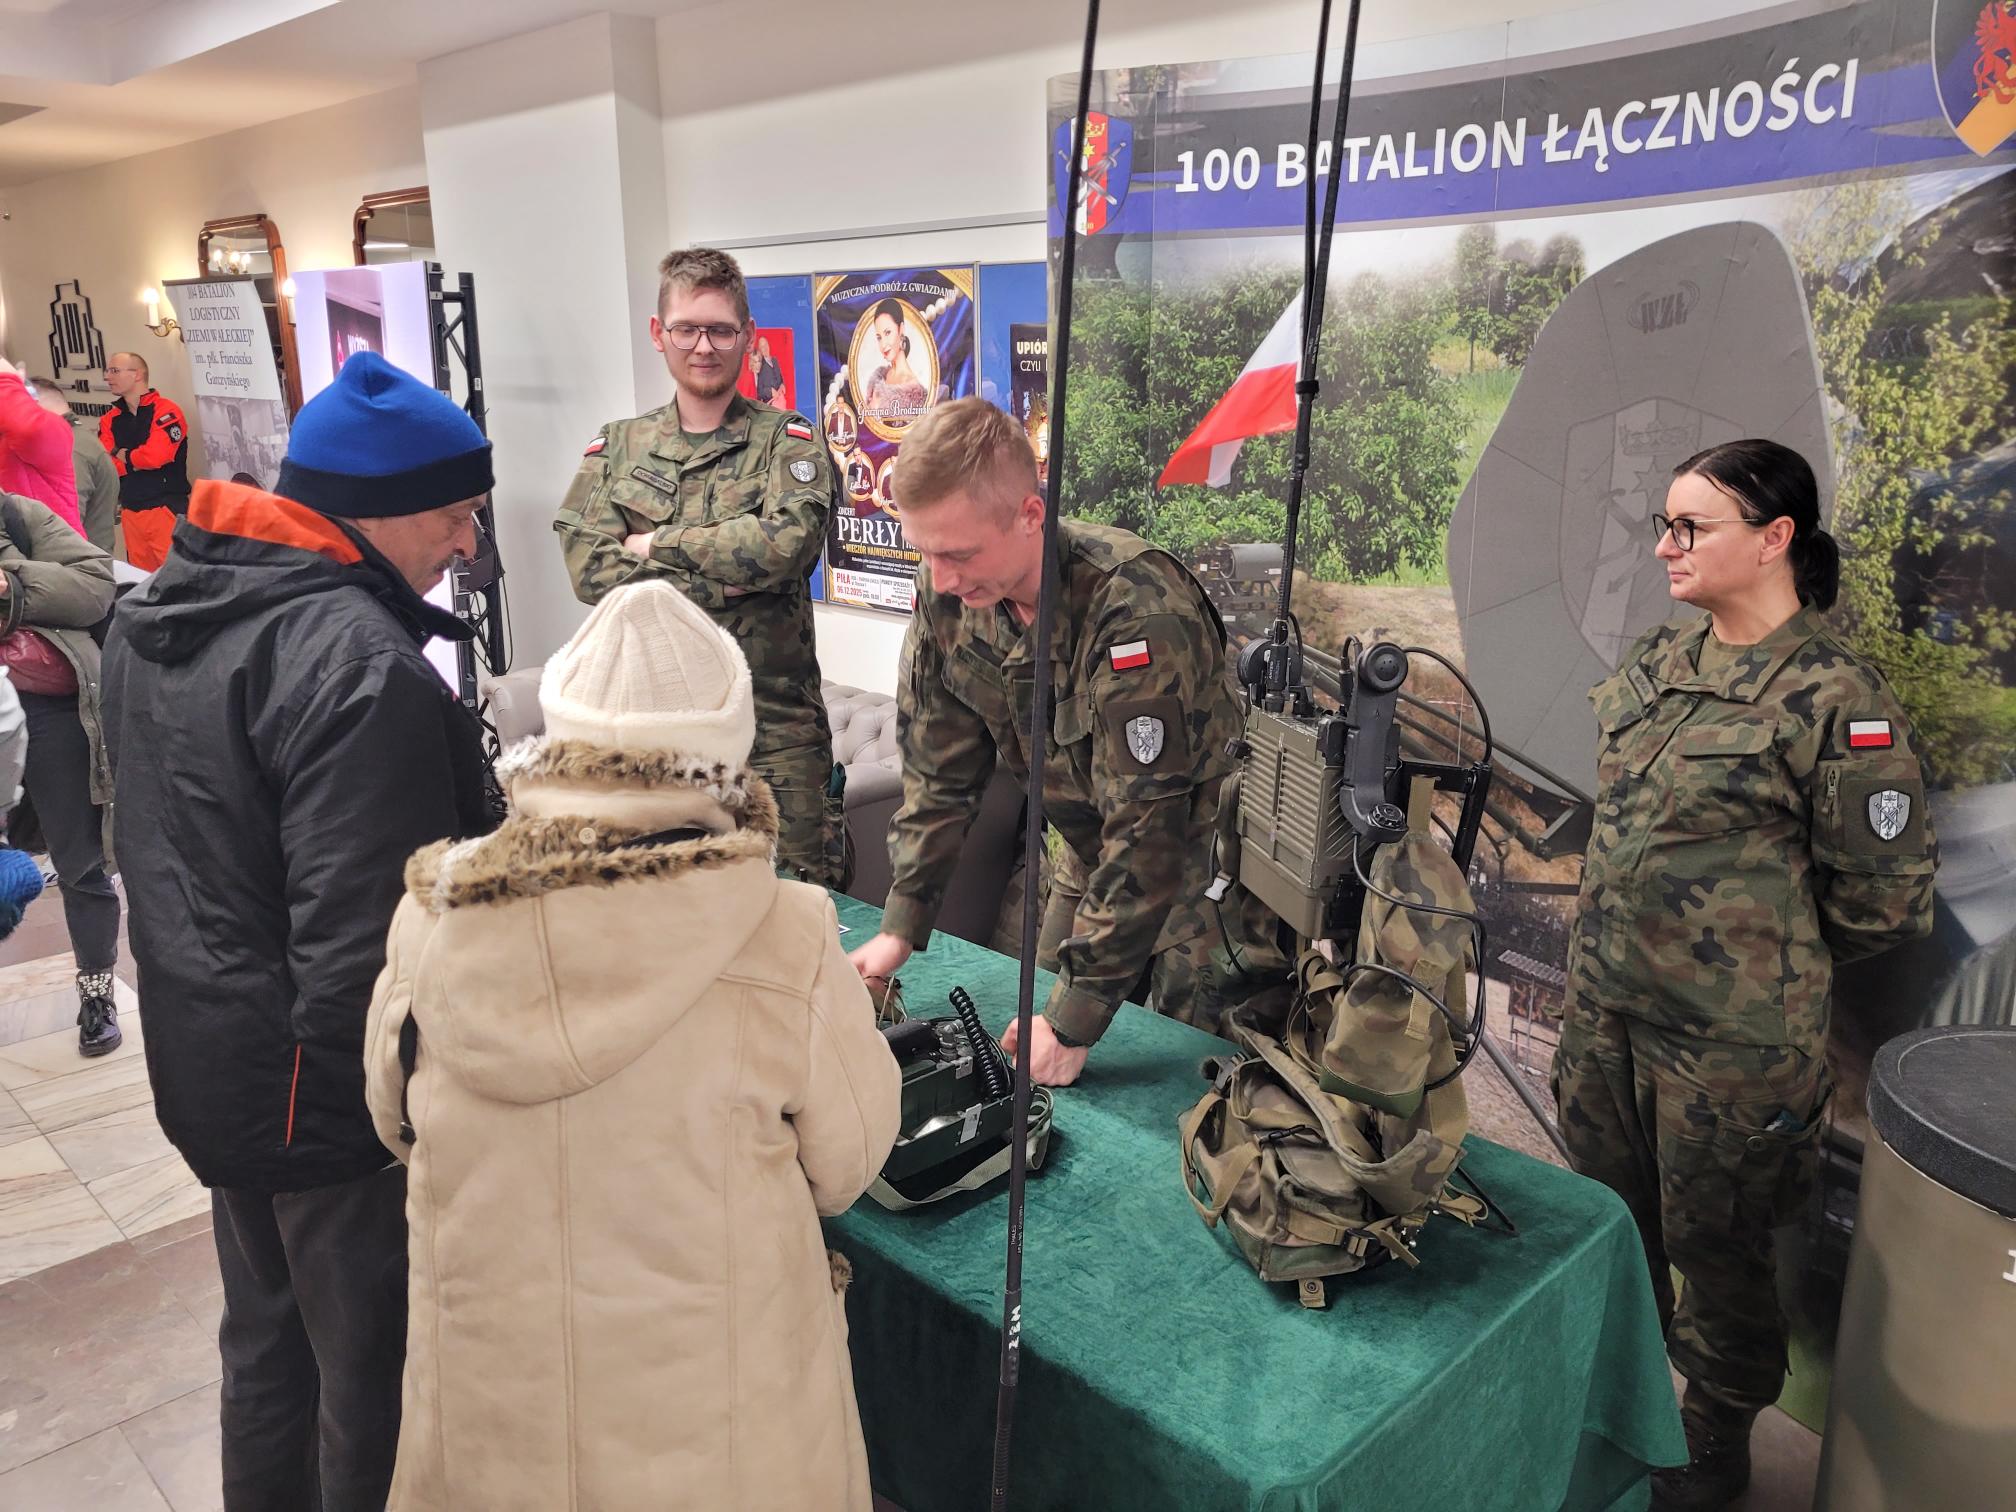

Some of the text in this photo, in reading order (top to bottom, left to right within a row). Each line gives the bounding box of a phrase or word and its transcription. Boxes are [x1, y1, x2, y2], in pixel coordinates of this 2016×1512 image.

[1175, 57, 1859, 193] 100 BATALION ŁĄCZNOŚCI
[197, 283, 235, 299] BATALION
[831, 285, 869, 304] MUZYCZNA
[870, 280, 902, 293] PODRÓŻ
[902, 282, 909, 292] Z
[189, 306, 240, 320] LOGISTYCZNY
[219, 350, 253, 365] Franciszka
[1020, 360, 1041, 372] CZYLI
[836, 516, 901, 548] PERŁY
[836, 572, 851, 585] PIŁA
